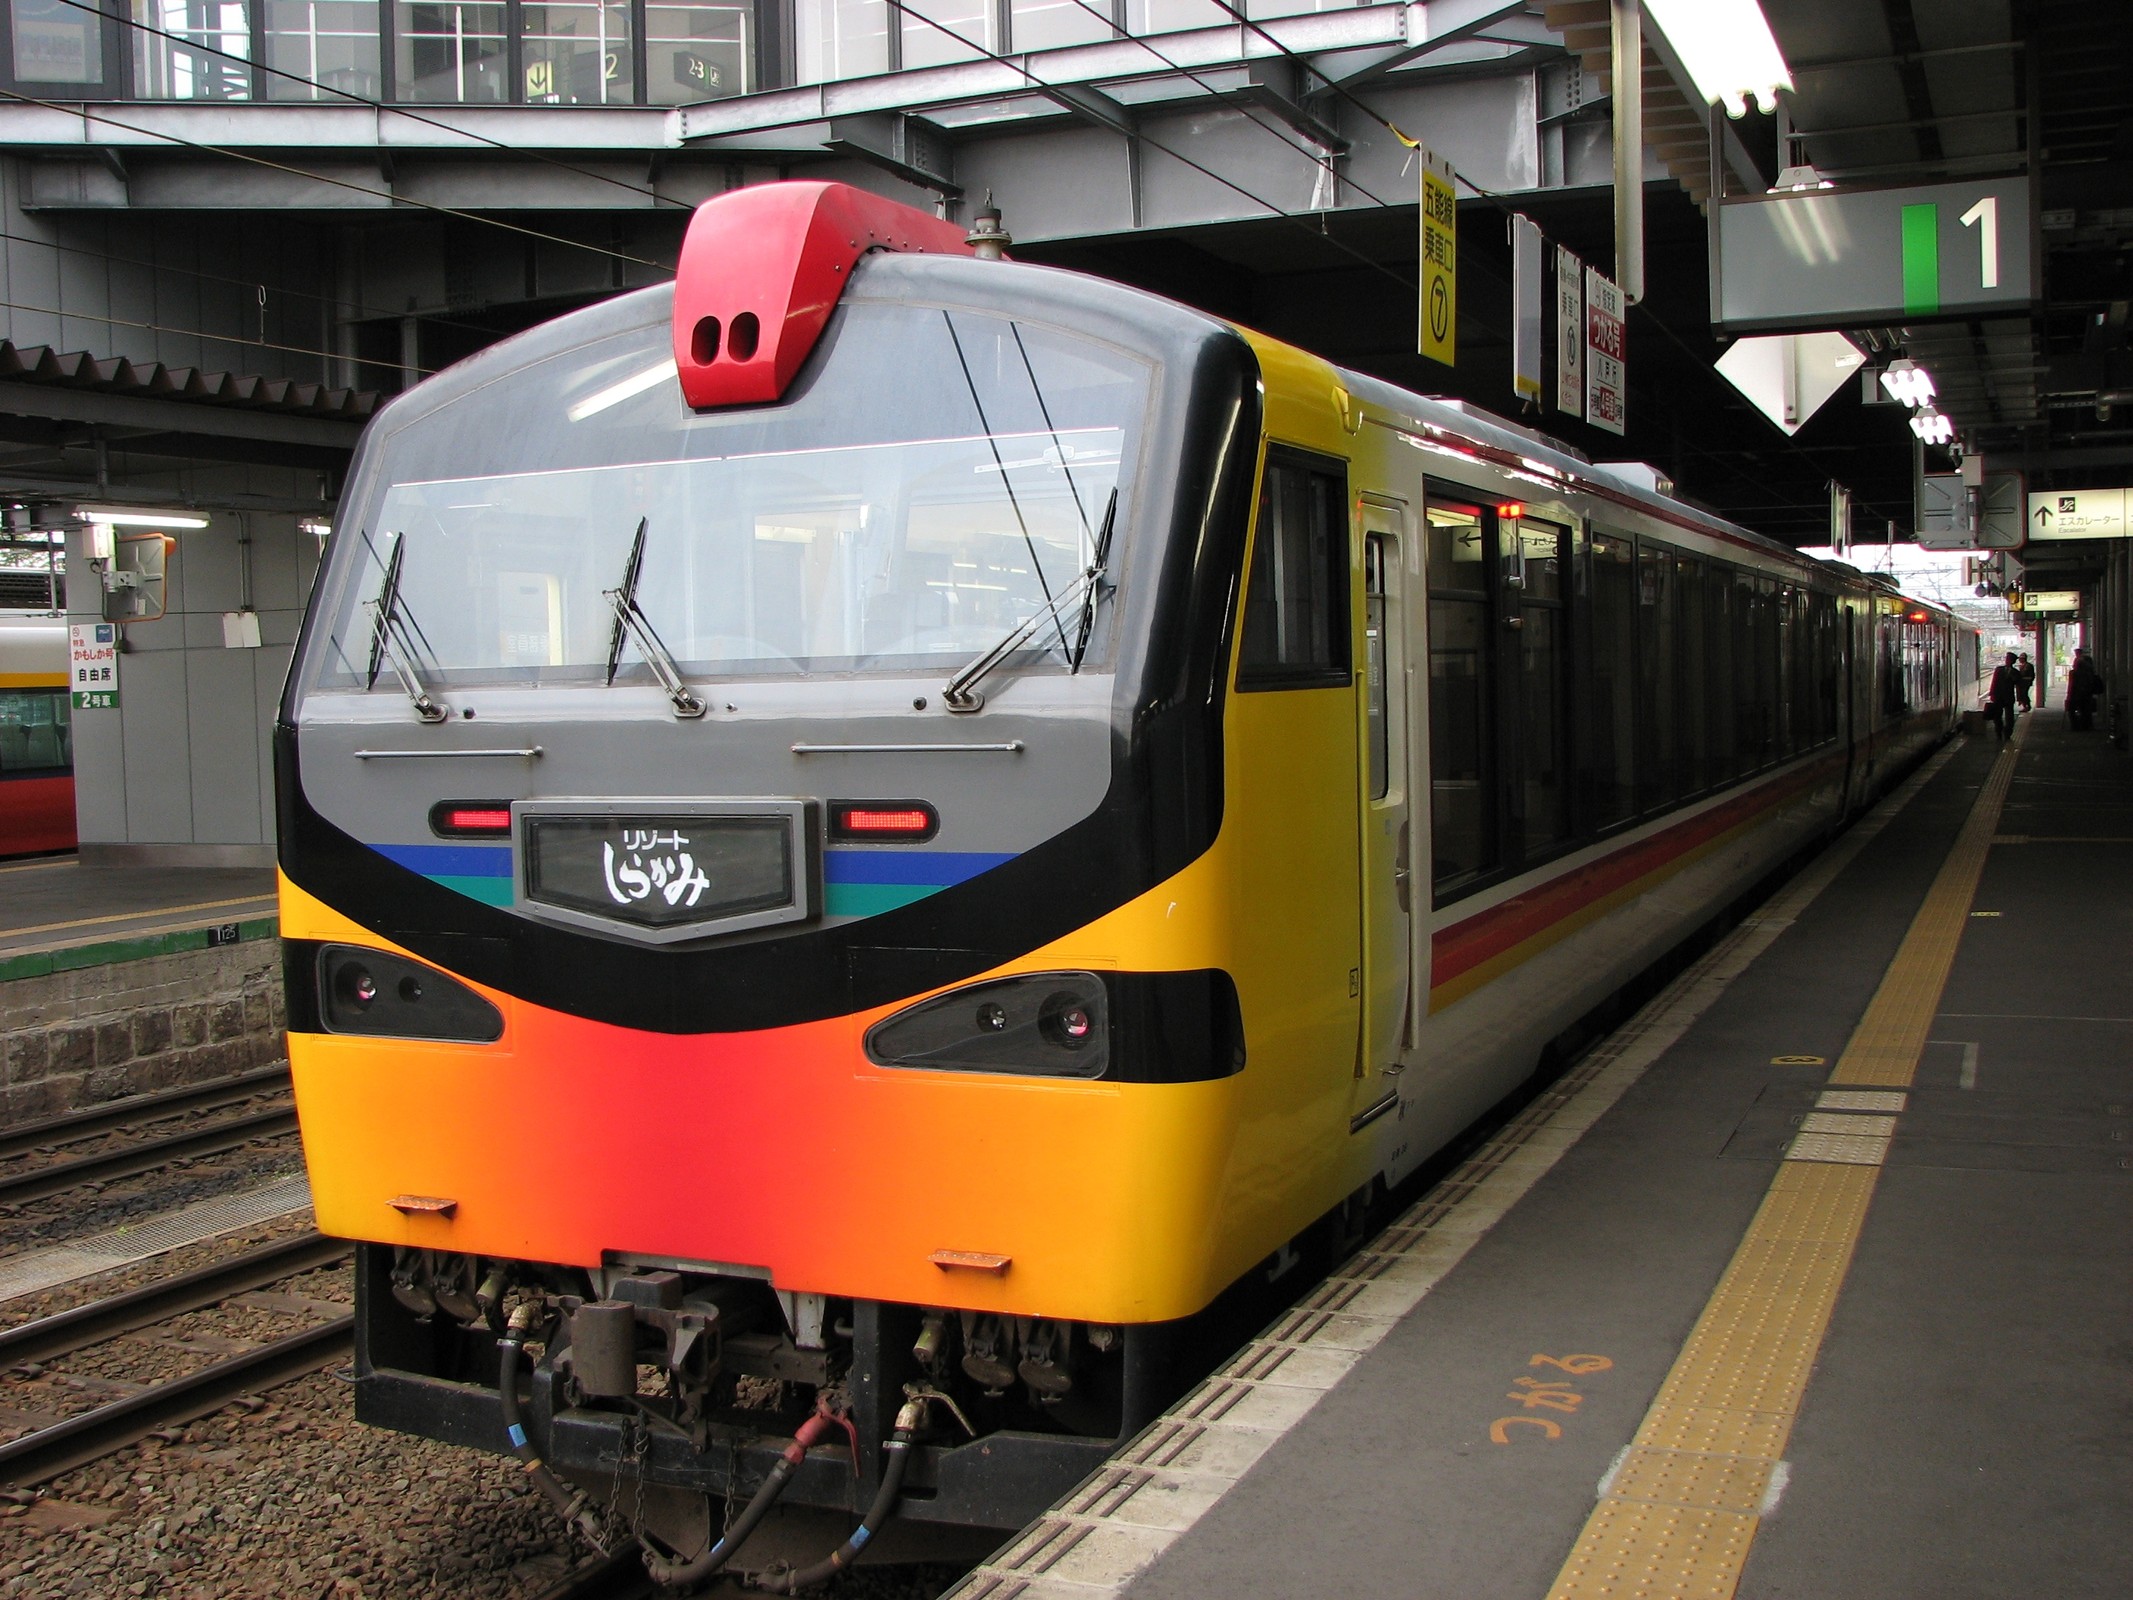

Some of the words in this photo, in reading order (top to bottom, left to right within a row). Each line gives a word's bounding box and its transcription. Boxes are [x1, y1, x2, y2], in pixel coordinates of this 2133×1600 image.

[1425, 181, 1454, 230] 五能線
[1425, 226, 1454, 274] 乗車口
[1959, 197, 1997, 289] 1
[1593, 314, 1620, 357] つがる号
[2058, 515, 2121, 526] エスカレーター
[73, 648, 115, 661] かもしか号
[79, 667, 112, 682] 自由席
[81, 691, 112, 708] 2号車
[623, 829, 690, 851] リゾート
[603, 840, 711, 907] しらかみ
[1489, 1353, 1613, 1444] つがる
